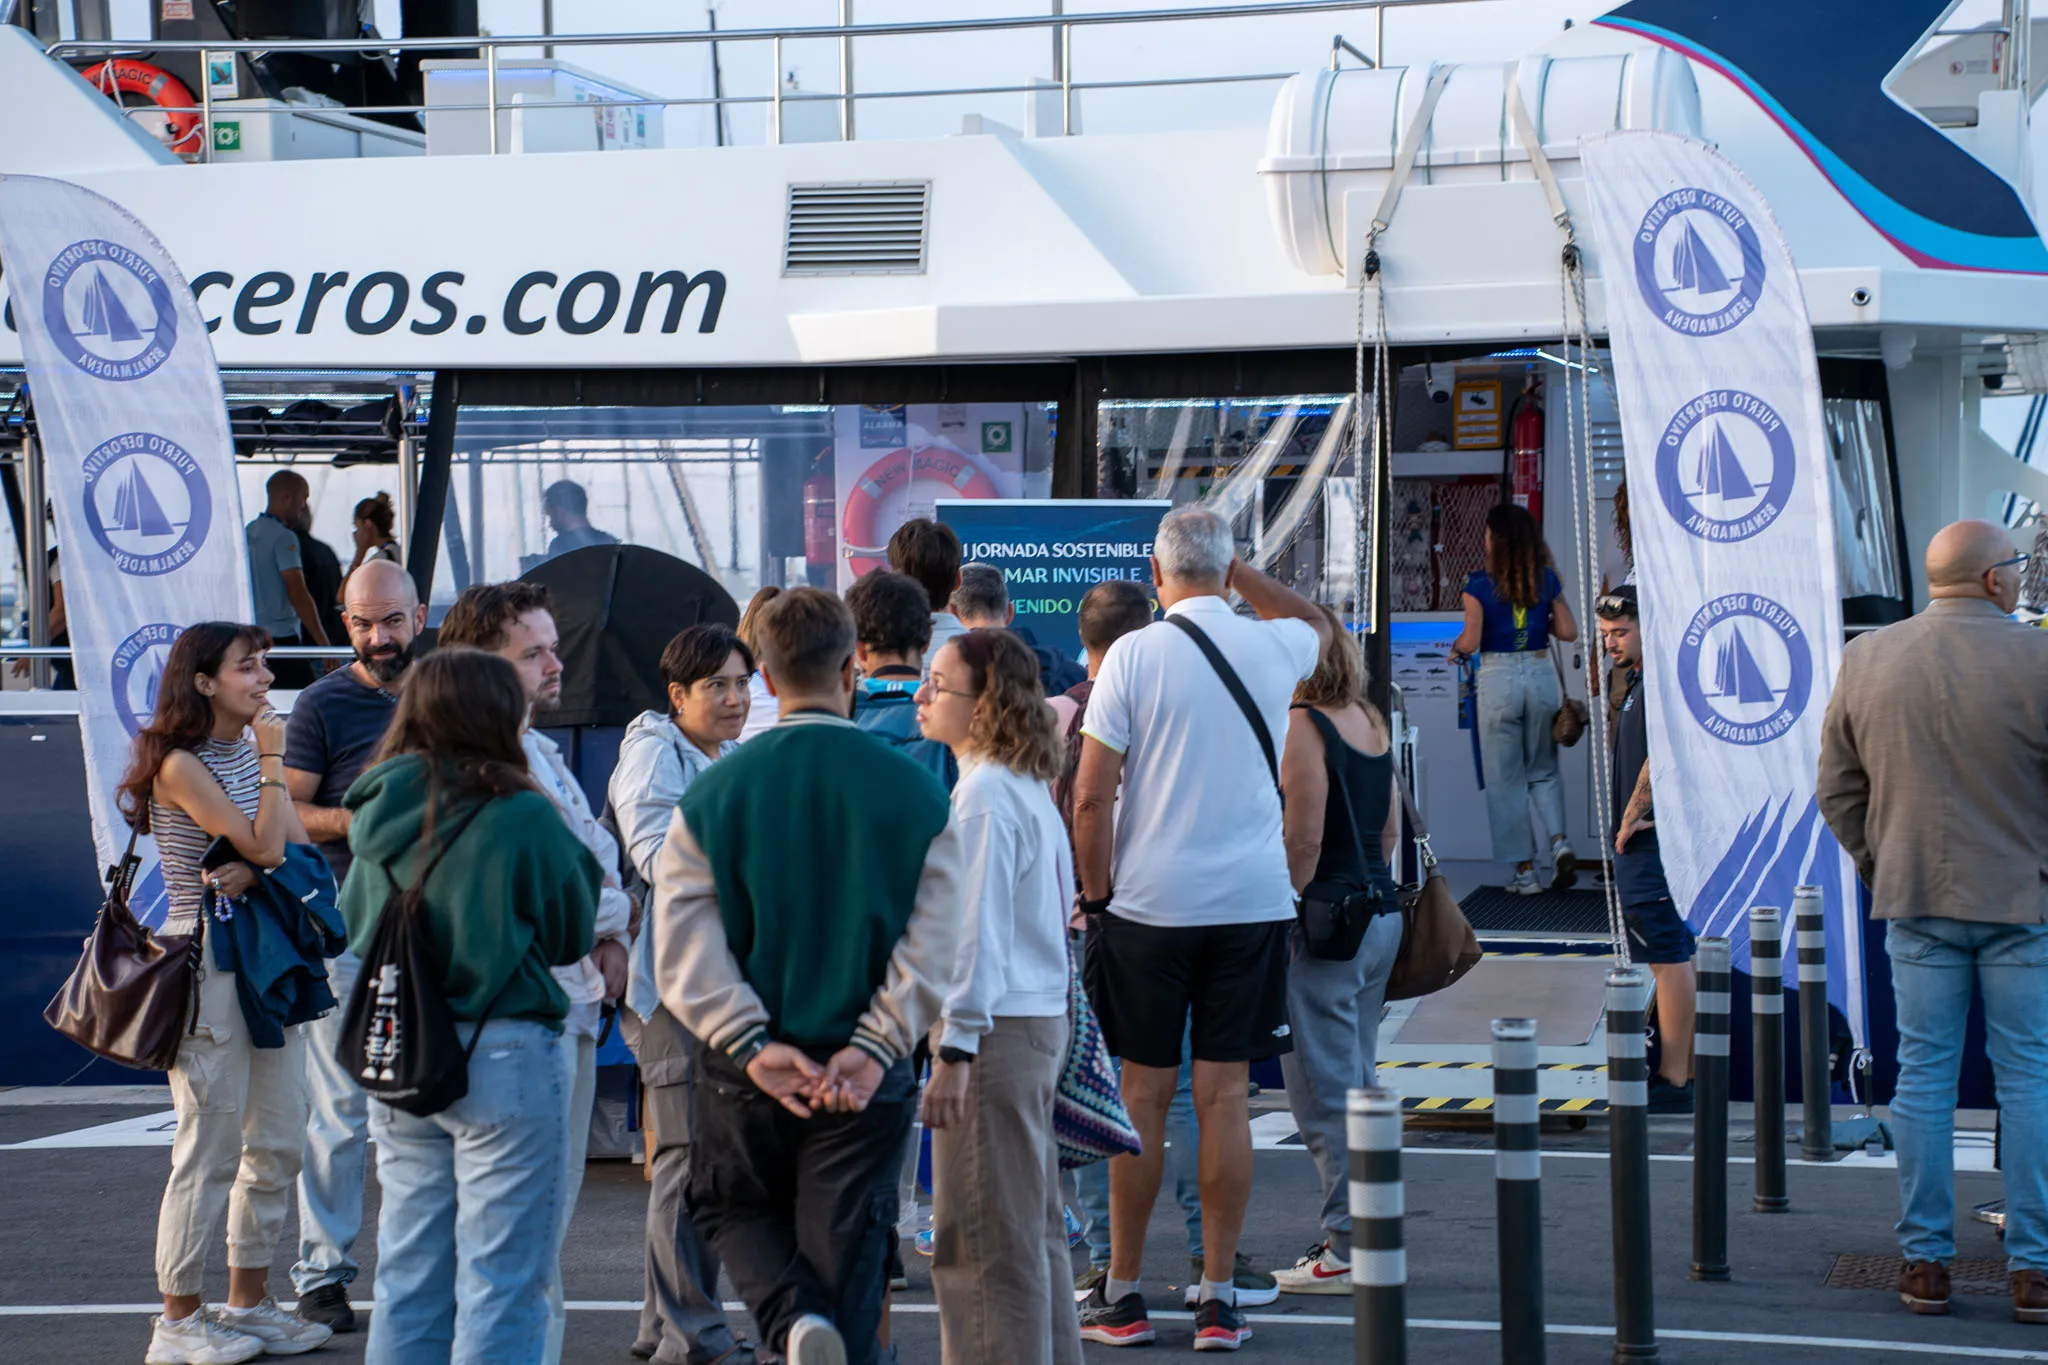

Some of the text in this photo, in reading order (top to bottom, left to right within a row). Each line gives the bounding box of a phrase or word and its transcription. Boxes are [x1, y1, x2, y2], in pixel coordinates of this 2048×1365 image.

[874, 460, 907, 488] NEW
[969, 542, 1050, 561] JORNADA
[1051, 542, 1154, 558] SOSTENIBLE
[1004, 567, 1142, 584] MAR INVISIBLE
[1012, 598, 1073, 614] ENIDO
